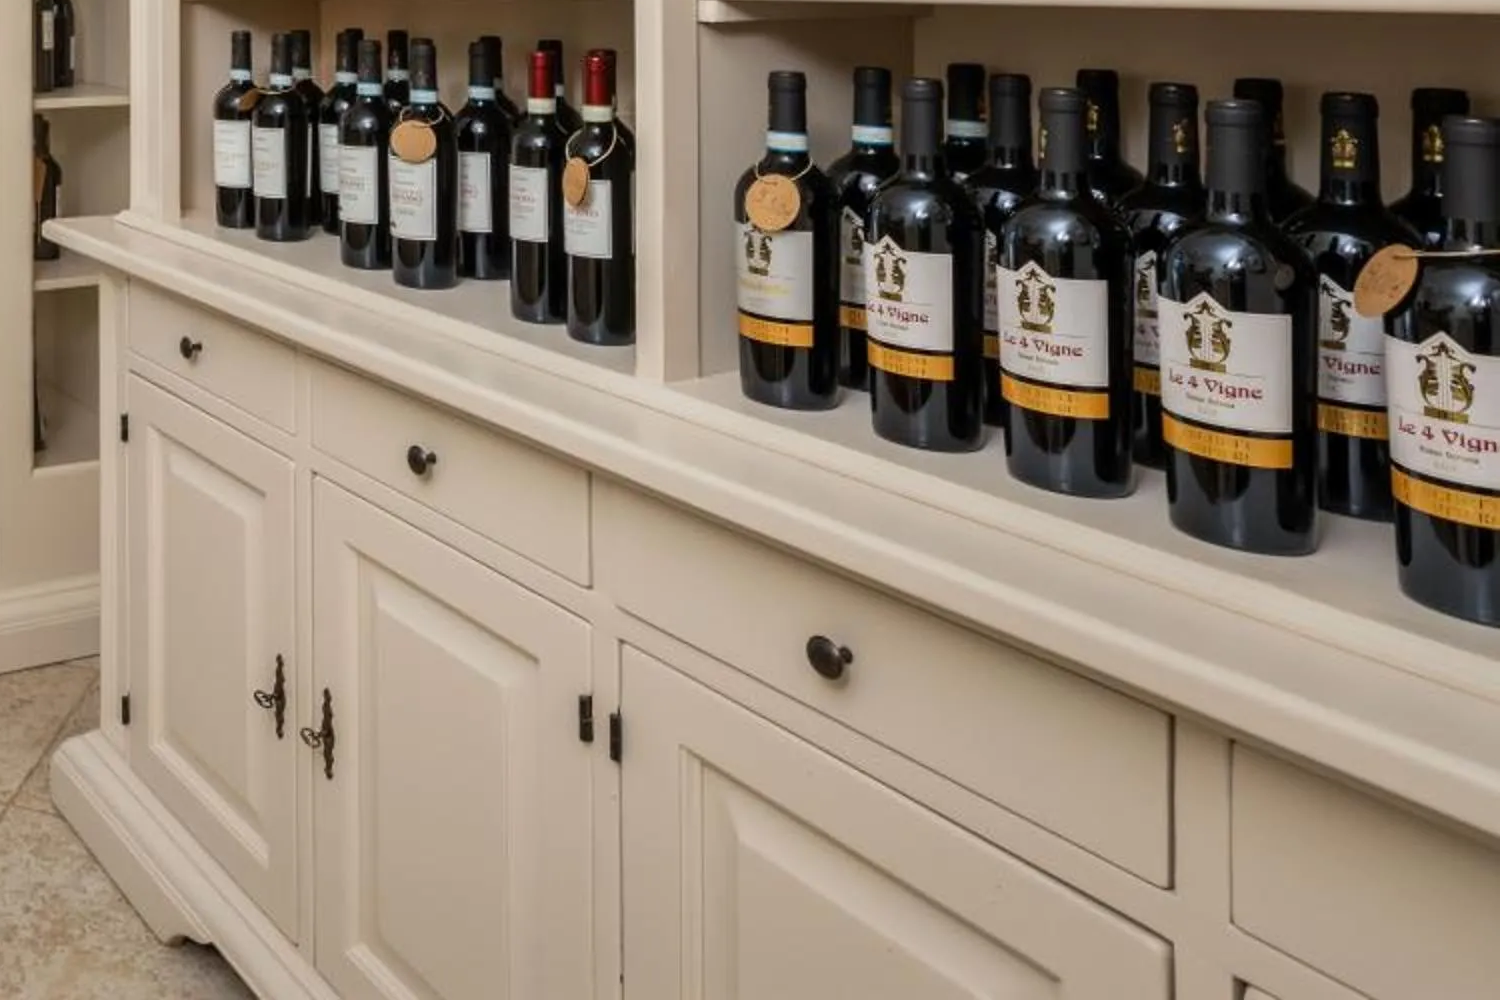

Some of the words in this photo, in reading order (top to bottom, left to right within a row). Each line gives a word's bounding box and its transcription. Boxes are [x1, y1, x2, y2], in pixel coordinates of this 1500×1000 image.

[1019, 336, 1029, 350] 4
[1033, 338, 1084, 358] Vigne
[1321, 354, 1381, 377] Vigne
[1168, 367, 1184, 386] Le
[1187, 374, 1199, 390] 4
[1203, 376, 1263, 400] Vigne
[1397, 414, 1417, 436] Le
[1421, 425, 1435, 441] 4
